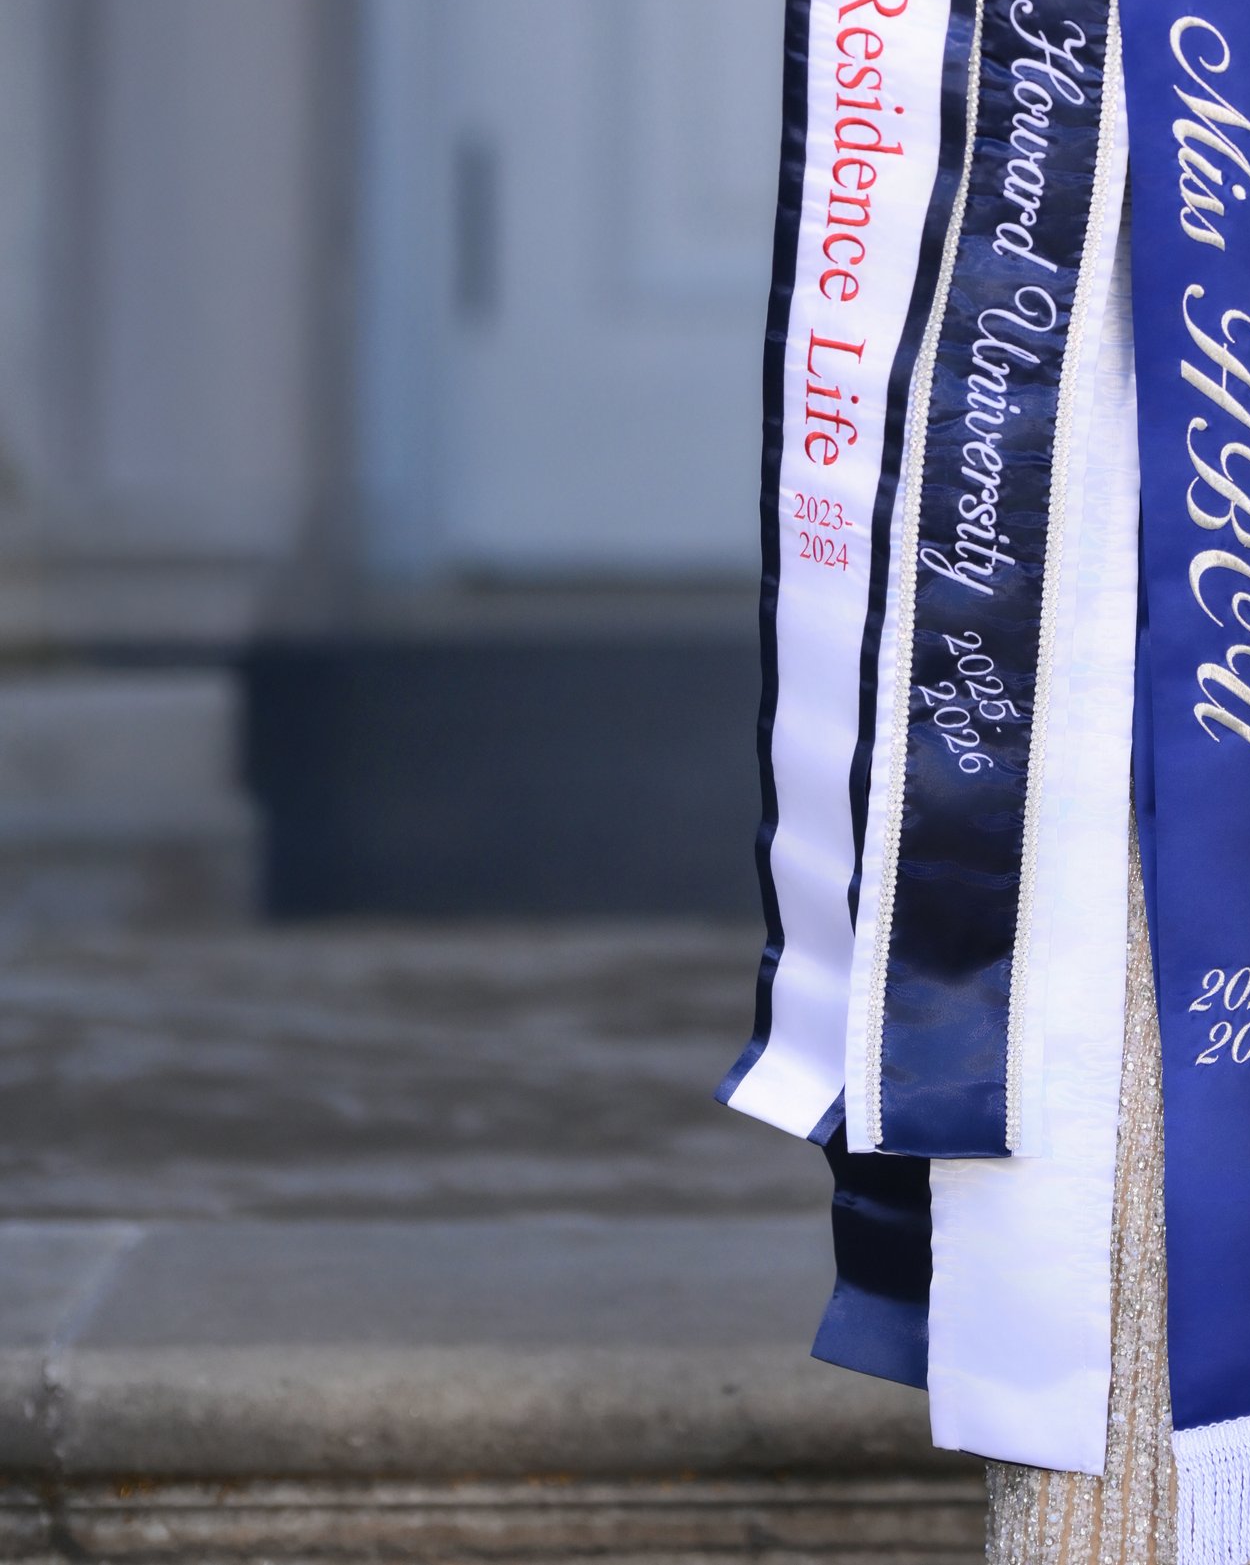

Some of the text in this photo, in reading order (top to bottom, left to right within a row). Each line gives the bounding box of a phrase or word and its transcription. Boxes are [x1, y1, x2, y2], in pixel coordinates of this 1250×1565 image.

[803, 328, 867, 467] Life
[919, 285, 1057, 596] University
[793, 493, 854, 530] 2023-
[799, 532, 850, 572] 2024
[918, 681, 994, 774] 2026
